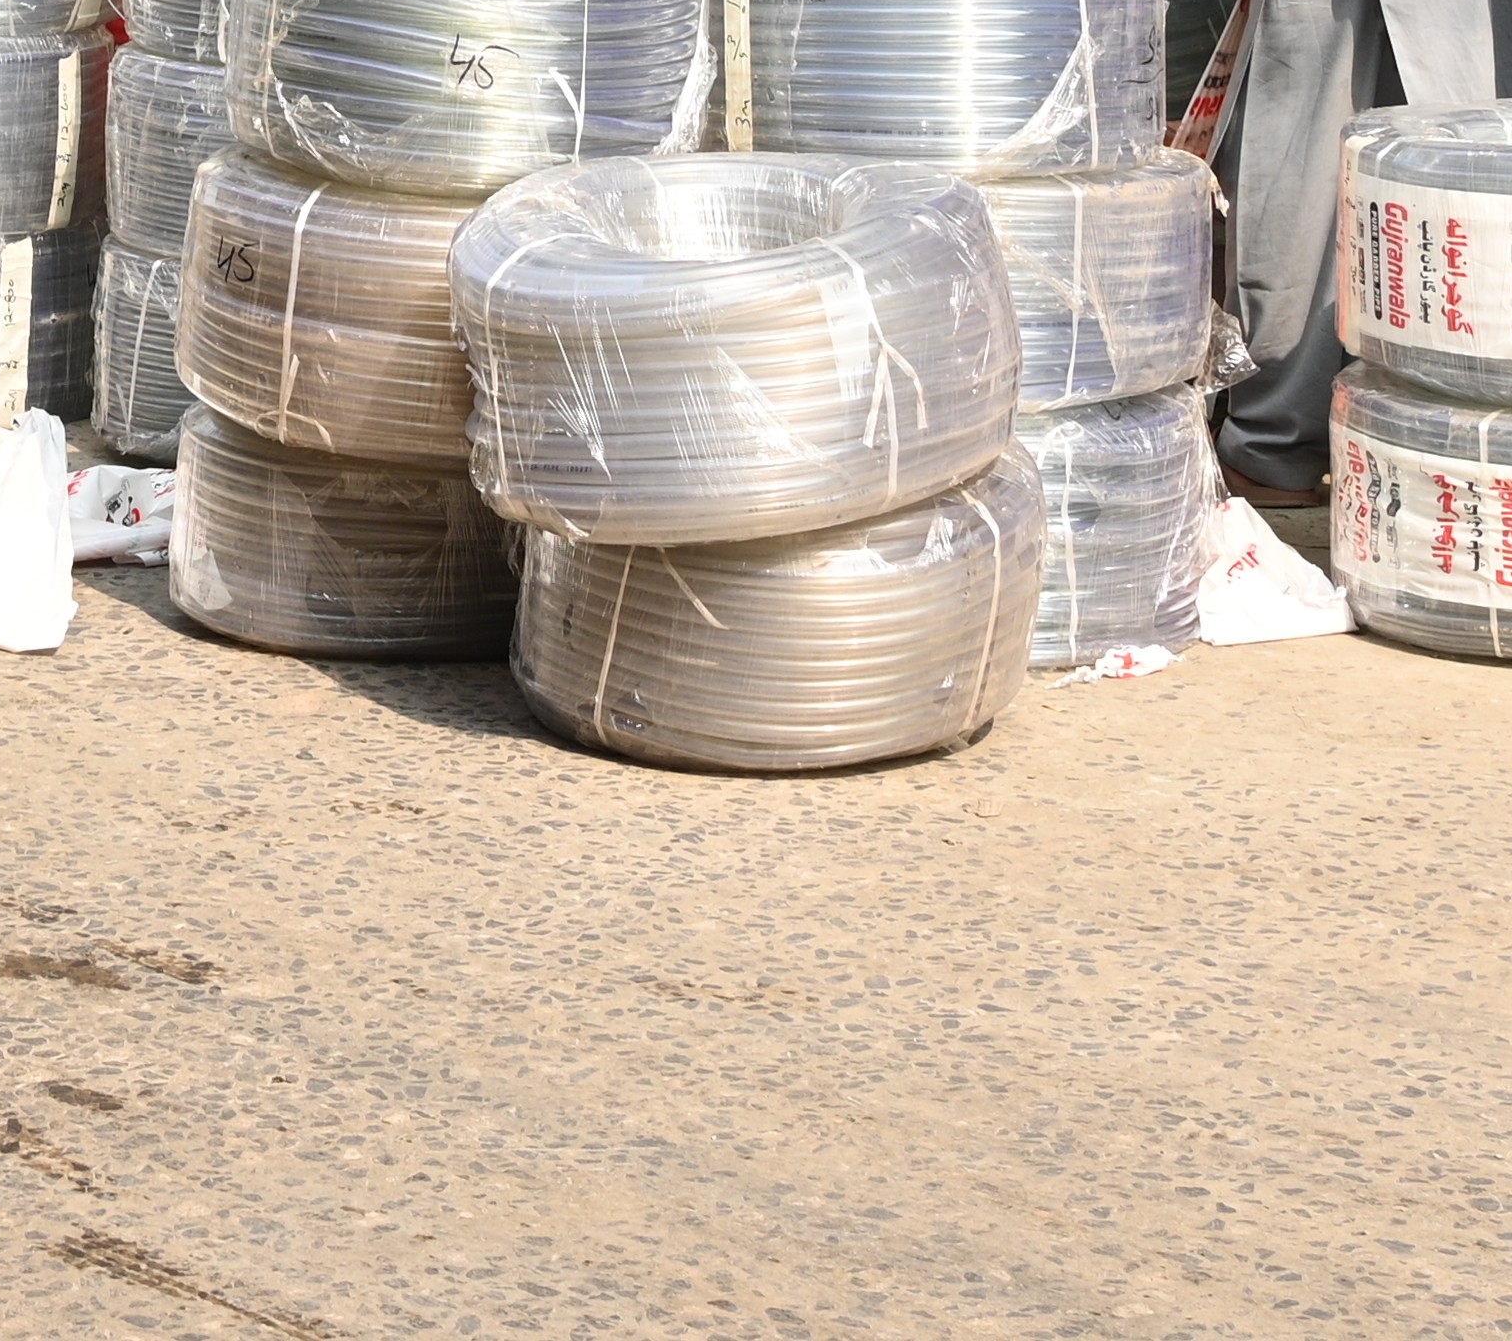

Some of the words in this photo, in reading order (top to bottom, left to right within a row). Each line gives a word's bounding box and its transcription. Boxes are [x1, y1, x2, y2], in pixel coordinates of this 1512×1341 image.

[218, 234, 258, 283] 45
[1381, 201, 1410, 330] Gujranwala
[1443, 217, 1475, 338] گوجرانوالہ
